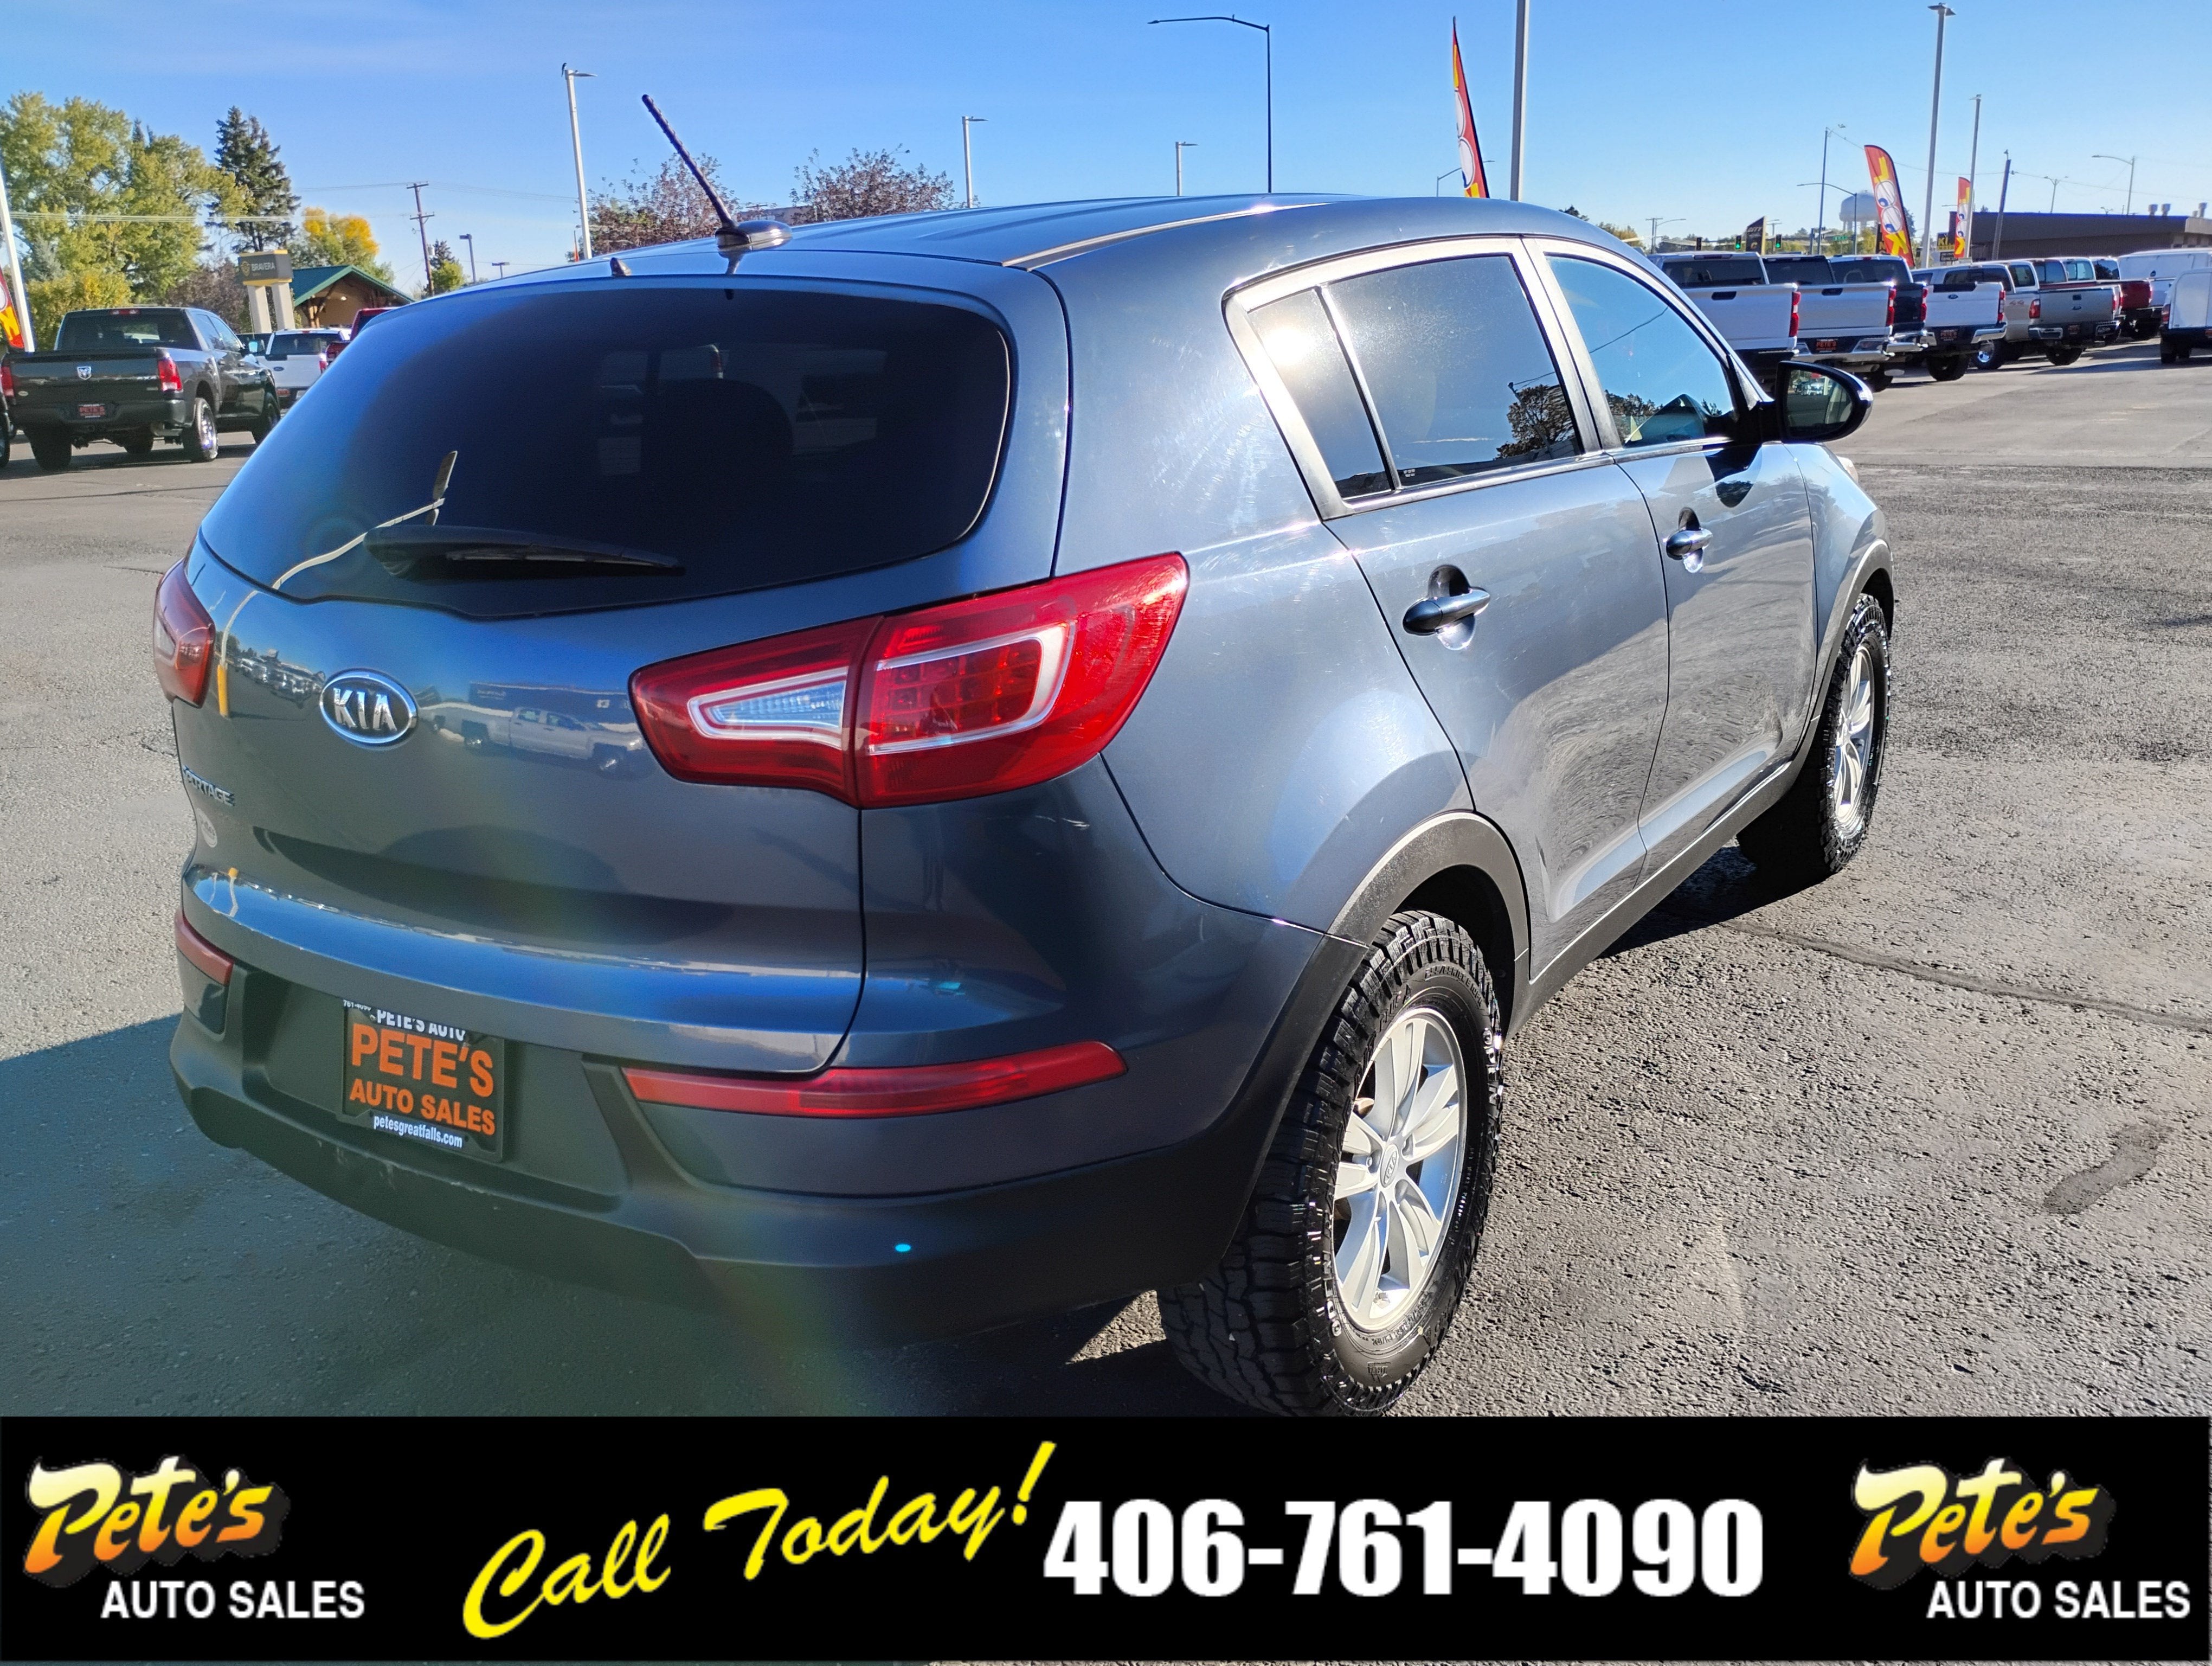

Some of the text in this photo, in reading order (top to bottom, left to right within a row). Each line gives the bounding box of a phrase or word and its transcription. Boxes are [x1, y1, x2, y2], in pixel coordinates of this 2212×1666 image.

[251, 262, 275, 271] BRAVERA
[333, 688, 397, 732] KIA
[352, 1023, 494, 1098] PETE'S
[350, 1079, 496, 1136] AUTO SALES
[374, 1115, 462, 1149] petesgreatfalls.com
